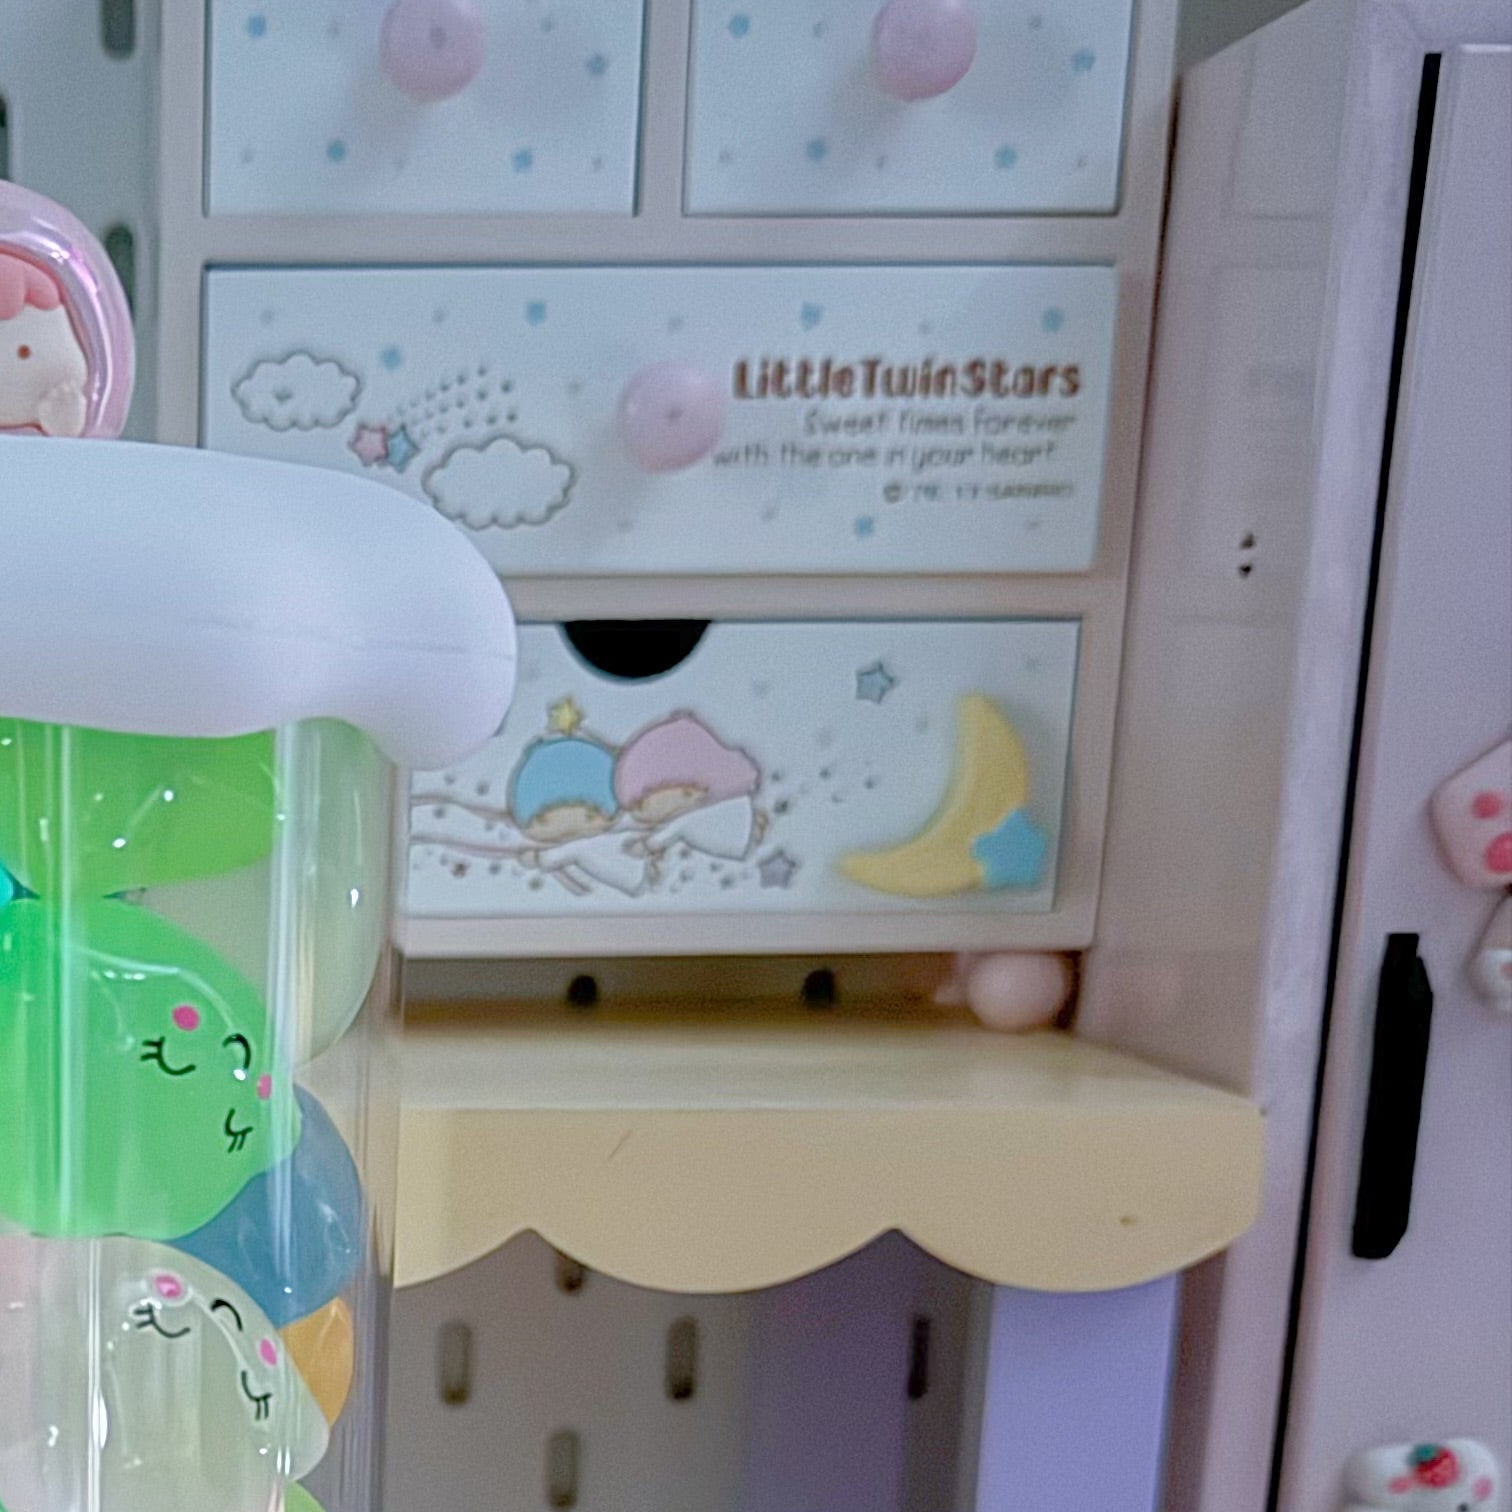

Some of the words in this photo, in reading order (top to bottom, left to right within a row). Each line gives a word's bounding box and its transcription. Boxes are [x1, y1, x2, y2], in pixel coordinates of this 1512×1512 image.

[804, 407, 886, 436] Sweet
[714, 440, 768, 467] with
[781, 440, 821, 467] the
[829, 448, 876, 467] one
[911, 447, 974, 473] your
[982, 440, 1056, 467] heart
